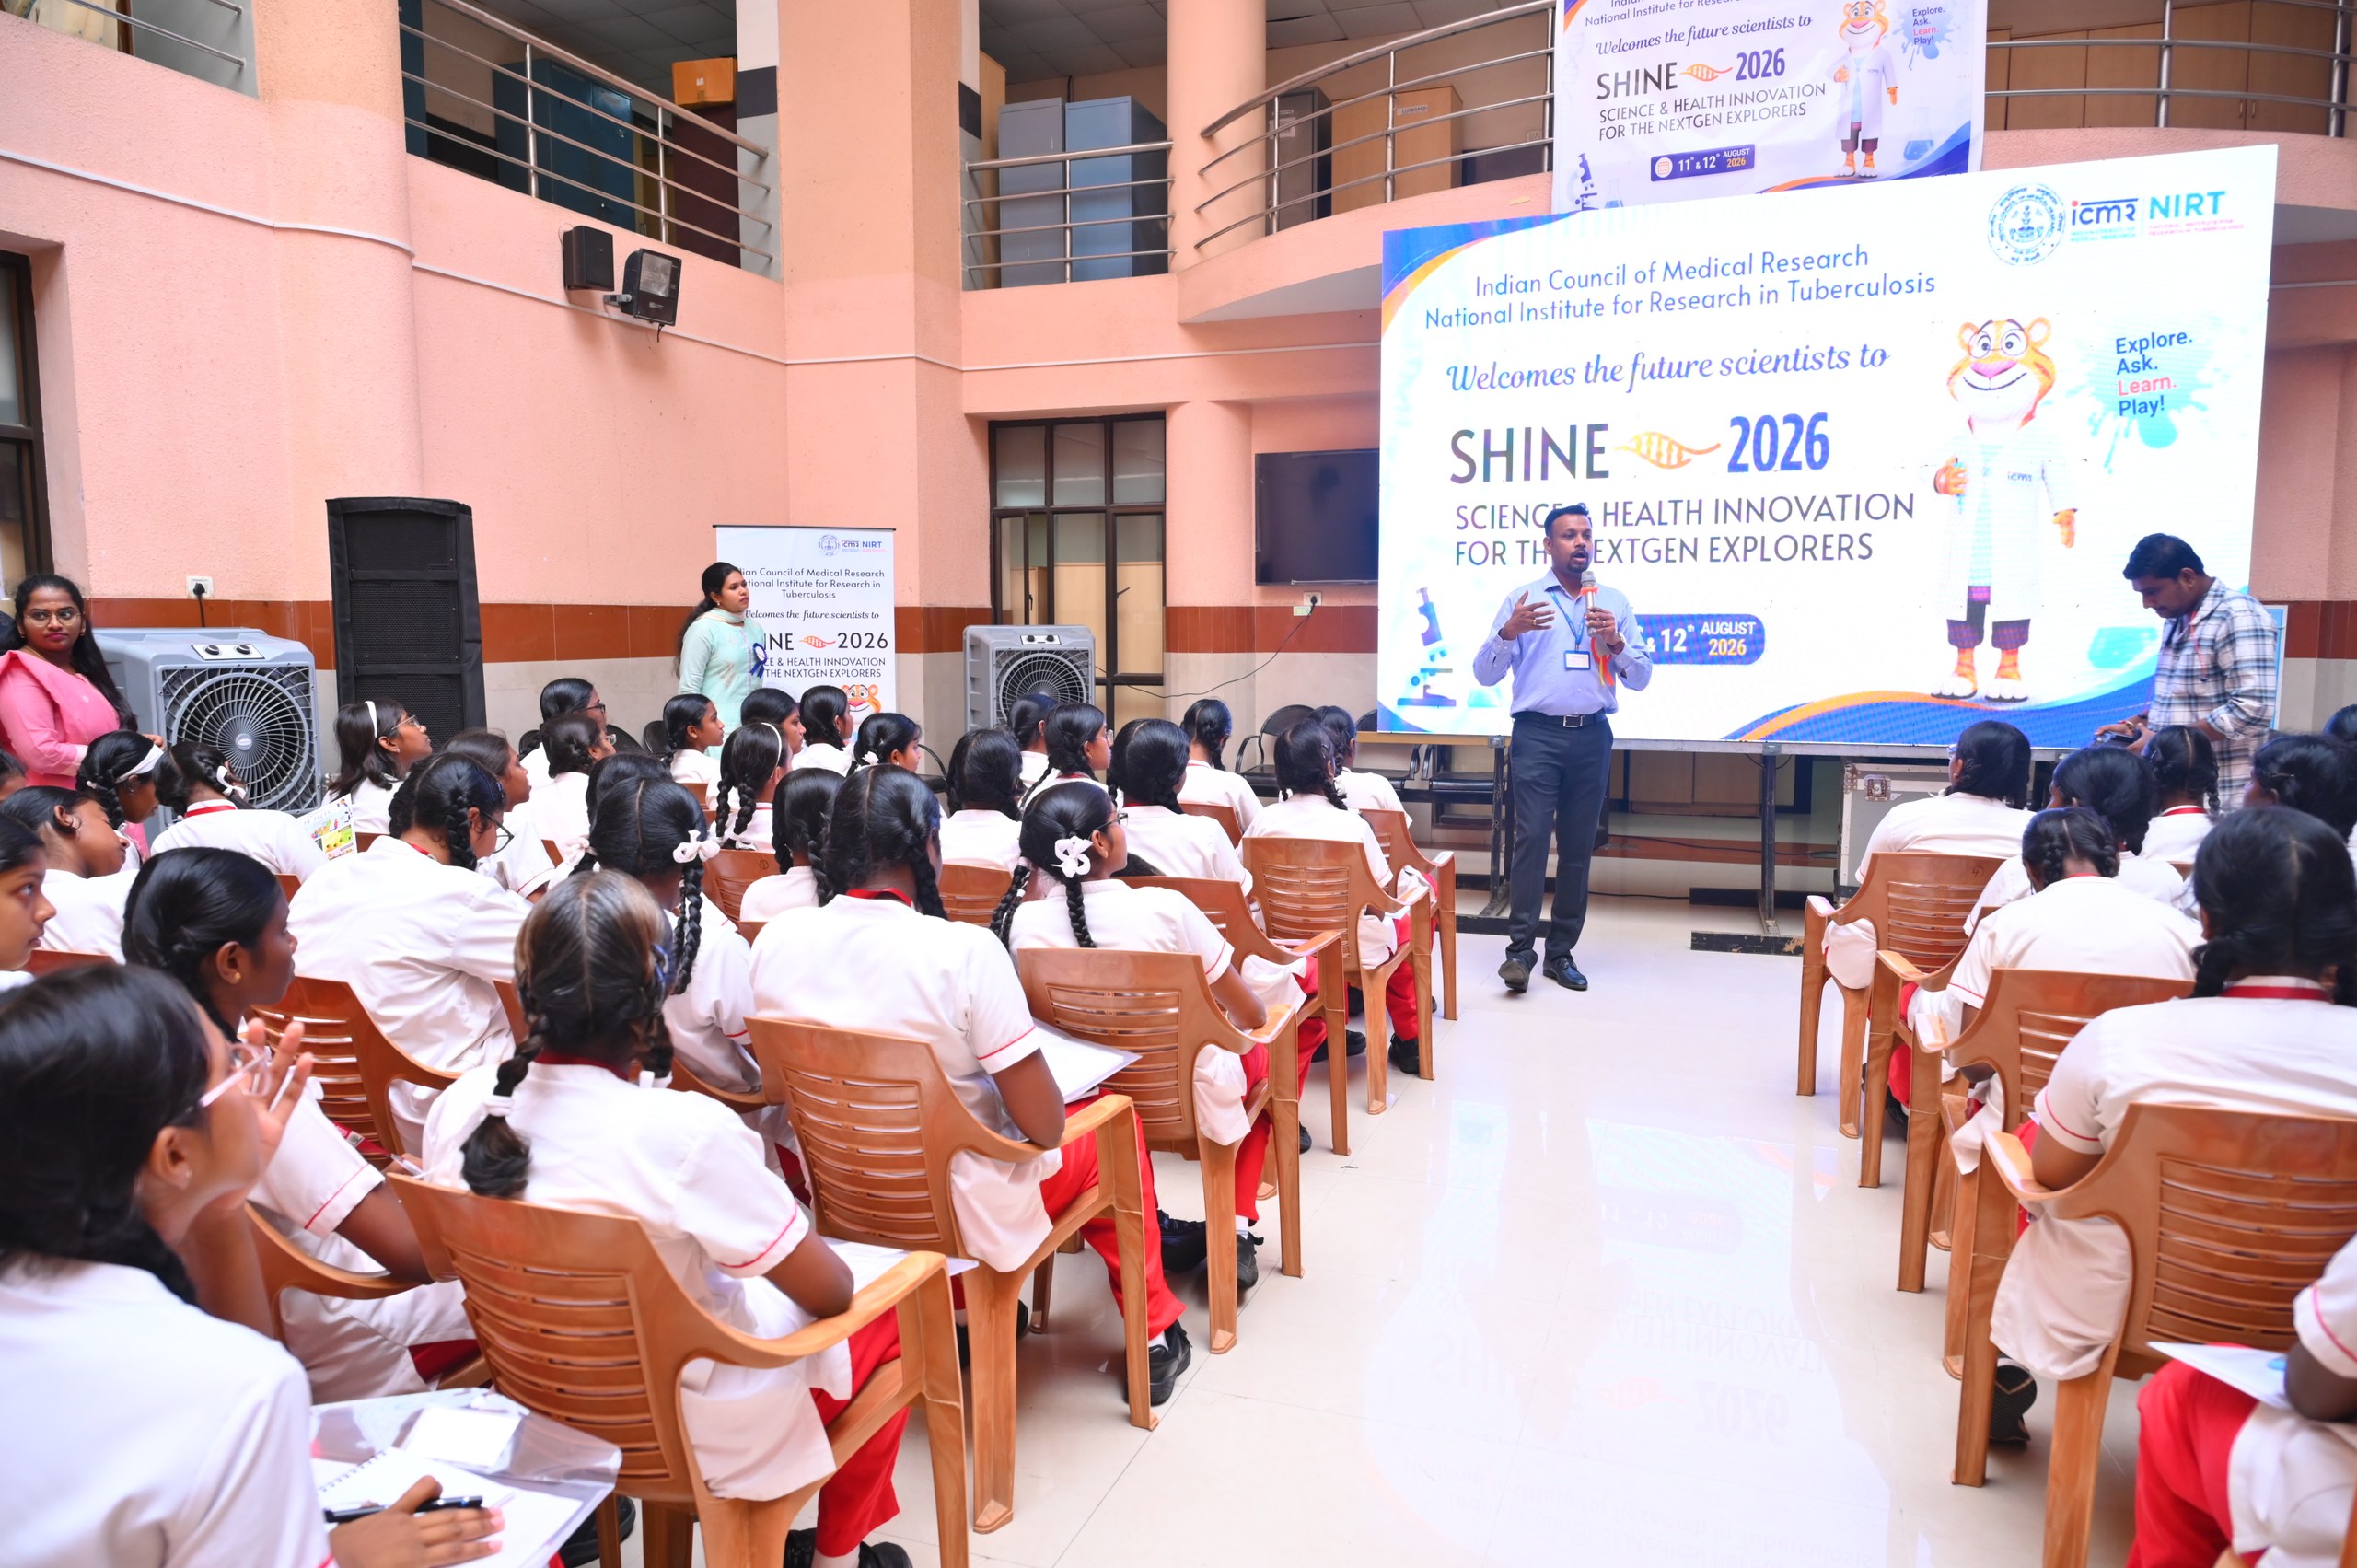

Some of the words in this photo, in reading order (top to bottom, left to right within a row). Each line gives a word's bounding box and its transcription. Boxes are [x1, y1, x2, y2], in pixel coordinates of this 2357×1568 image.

[1585, 8, 1630, 27] National
[1633, 2, 1676, 18] Institute
[1679, 0, 1694, 9] for
[1912, 6, 1945, 17] Explore.
[1913, 17, 1932, 27] Ask.
[1596, 34, 1661, 55] Welcomes
[1665, 28, 1686, 43] the
[1686, 25, 1729, 46] future
[1731, 17, 1794, 35] scientists
[1798, 15, 1813, 27] to
[1913, 27, 1939, 36] Learn.
[1914, 35, 1934, 46] Play!
[1596, 62, 1678, 100] SHINE
[1736, 48, 1786, 81] 2026
[1599, 103, 1655, 123] SCIENCE
[1660, 101, 1669, 115] &
[1674, 94, 1724, 113] HEALTH
[1729, 83, 1826, 107] INNOVATION
[1599, 124, 1625, 141] FOR
[1631, 121, 1655, 135] THE
[1658, 112, 1722, 132] NEXTGEN
[1726, 102, 1806, 124] EXPLORERS
[1723, 147, 1750, 158] AUGUST
[1695, 161, 1701, 170] &
[1726, 157, 1747, 168] 2026
[2149, 191, 2226, 220] NIRT
[1476, 273, 1541, 296] Indian
[1550, 263, 1626, 290] Council
[1634, 261, 1657, 284] of
[1663, 253, 1753, 282] Medical
[1761, 244, 1868, 274] Research
[1426, 302, 1512, 329] National
[1520, 298, 1605, 322] Institute
[1613, 294, 1643, 316] for
[1650, 284, 1751, 313] Research
[1759, 284, 1779, 305] in
[1788, 272, 1935, 303] Tuberculosis
[2116, 331, 2193, 355] Explore.
[1446, 361, 1575, 392] Welcomes
[1584, 354, 1625, 384] the
[1626, 352, 1713, 394] future
[1720, 345, 1849, 377] scientists
[1859, 343, 1891, 368] to
[2117, 354, 2158, 376] Ask.
[2118, 376, 2177, 397] Learn.
[2119, 395, 2165, 417] Play!
[1450, 423, 1610, 485] SHINE
[1727, 412, 1830, 474] 2026
[1456, 503, 1563, 530] SCIENC
[1603, 498, 1703, 527] HEALTH
[1713, 492, 1915, 525] INNOVATION
[862, 540, 883, 549] NIRT
[1456, 540, 1507, 566] FOR
[1516, 540, 1548, 565] TH
[1594, 536, 1699, 564] EXTGEN
[1710, 532, 1875, 563] EXPLORERS
[760, 567, 793, 576] Council
[795, 567, 805, 576] of
[807, 568, 842, 577] Medical
[844, 568, 885, 577] Research
[747, 579, 774, 587] tional
[776, 578, 813, 587] Institute
[816, 578, 828, 588] for
[830, 579, 870, 588] Research
[873, 580, 881, 588] in
[782, 589, 836, 598] Tuberculosis
[786, 609, 800, 619] the
[802, 609, 830, 622] future
[830, 610, 869, 619] scientists
[1700, 621, 1757, 635] AUGUST
[837, 632, 888, 649] 2026
[1708, 638, 1747, 656] 2026
[777, 657, 784, 667] &
[786, 657, 820, 667] HEALTH
[823, 657, 886, 667] INNOVATION
[765, 668, 782, 678] THE
[784, 668, 828, 678] NEXTGEN
[830, 668, 882, 678] EXPLORERS
